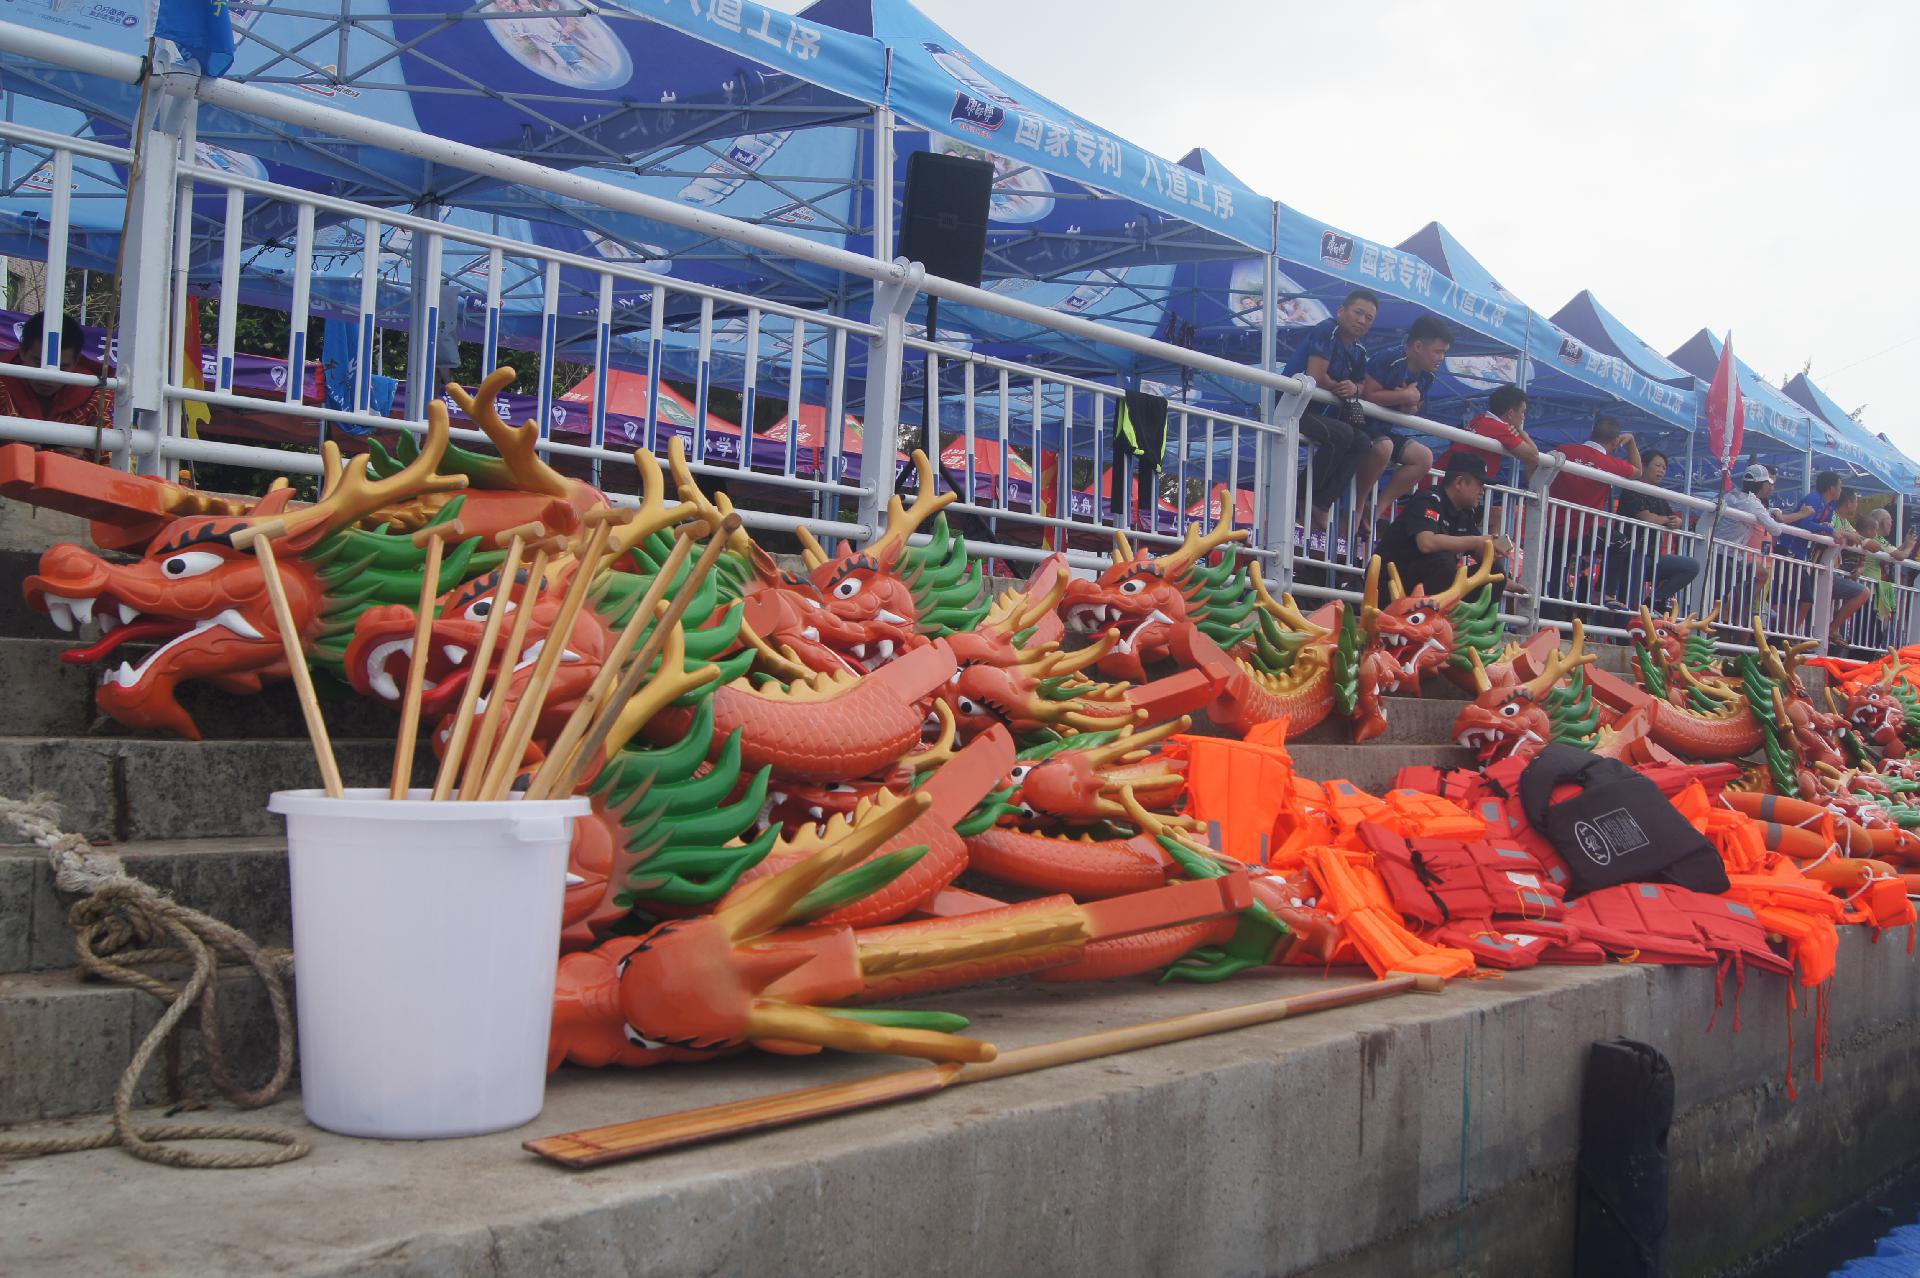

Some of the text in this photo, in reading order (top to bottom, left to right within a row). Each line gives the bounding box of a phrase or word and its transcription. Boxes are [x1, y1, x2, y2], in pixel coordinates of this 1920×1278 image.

[1014, 114, 1234, 219] 国家专利 八道工序
[1359, 243, 1508, 328] 国家专利 八道工序
